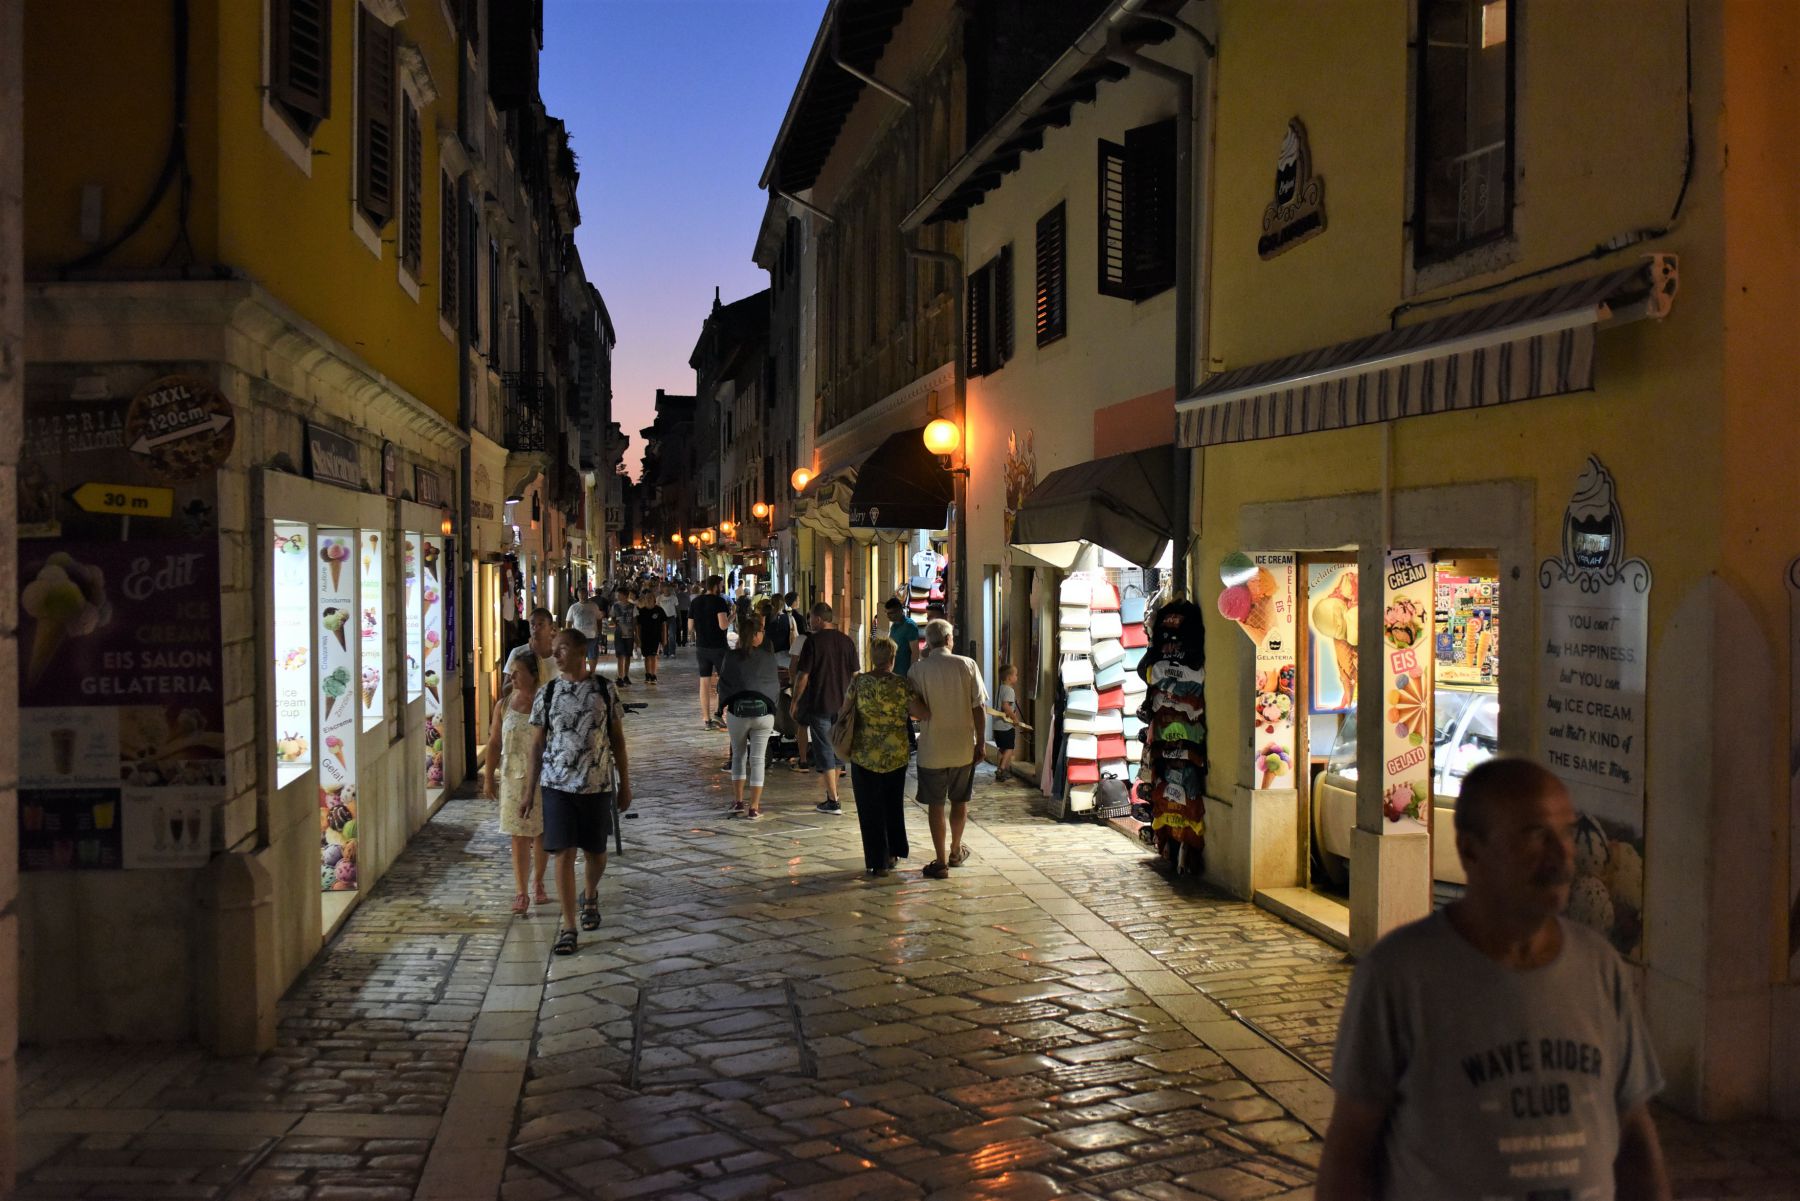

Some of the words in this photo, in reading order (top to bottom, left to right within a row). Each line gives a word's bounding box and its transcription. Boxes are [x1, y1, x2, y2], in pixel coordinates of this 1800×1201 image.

[148, 385, 191, 409] XXXL
[150, 405, 204, 431] 120cm
[104, 493, 125, 507] 30
[131, 498, 148, 508] m
[1256, 555, 1267, 565] ICE
[1269, 555, 1293, 565] CREAM
[1394, 556, 1411, 572] ICE
[122, 553, 205, 600] Edit
[925, 563, 931, 578] 7
[1389, 566, 1425, 589] CREAM
[177, 602, 211, 619] ICE
[1275, 600, 1285, 613] EIS
[1568, 615, 1592, 629] YOU
[136, 625, 211, 643] CREAM
[104, 651, 135, 670] EIS
[141, 650, 213, 669] SALON
[1393, 651, 1416, 672] EIS
[81, 676, 214, 694] GELATERIA
[1579, 672, 1602, 688] YOU
[282, 688, 297, 698] ice
[281, 709, 300, 719] cup
[1565, 698, 1583, 714] ICE
[1589, 730, 1620, 748] KIND
[1622, 735, 1633, 755] of
[1388, 747, 1426, 775] GELATO
[1548, 750, 1570, 768] THE
[1573, 755, 1606, 775] SAME
[1462, 1040, 1532, 1088] WAVE
[1540, 1038, 1602, 1079] RIDER
[1511, 1083, 1571, 1119] CLUB
